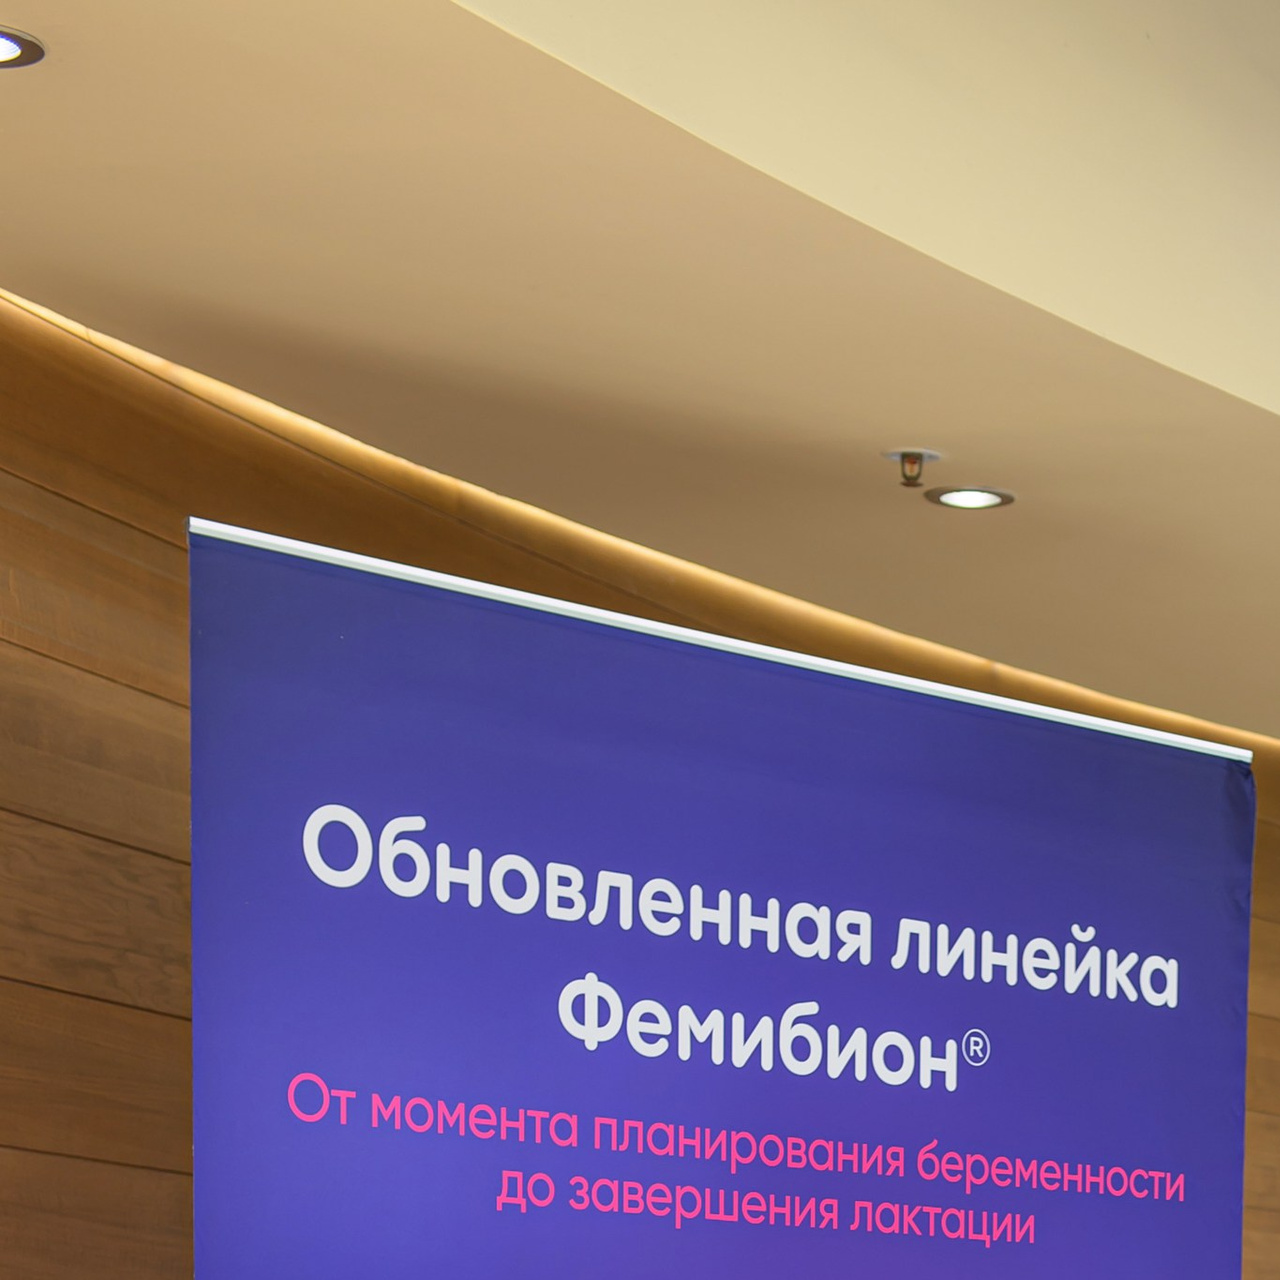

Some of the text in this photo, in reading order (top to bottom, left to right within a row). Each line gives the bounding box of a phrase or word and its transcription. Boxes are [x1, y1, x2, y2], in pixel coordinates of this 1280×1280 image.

[302, 803, 1179, 1009] Обновленная линейка
[287, 1072, 1186, 1202] От момента планирования беременности
[496, 1170, 1036, 1248] до завершения лактации
